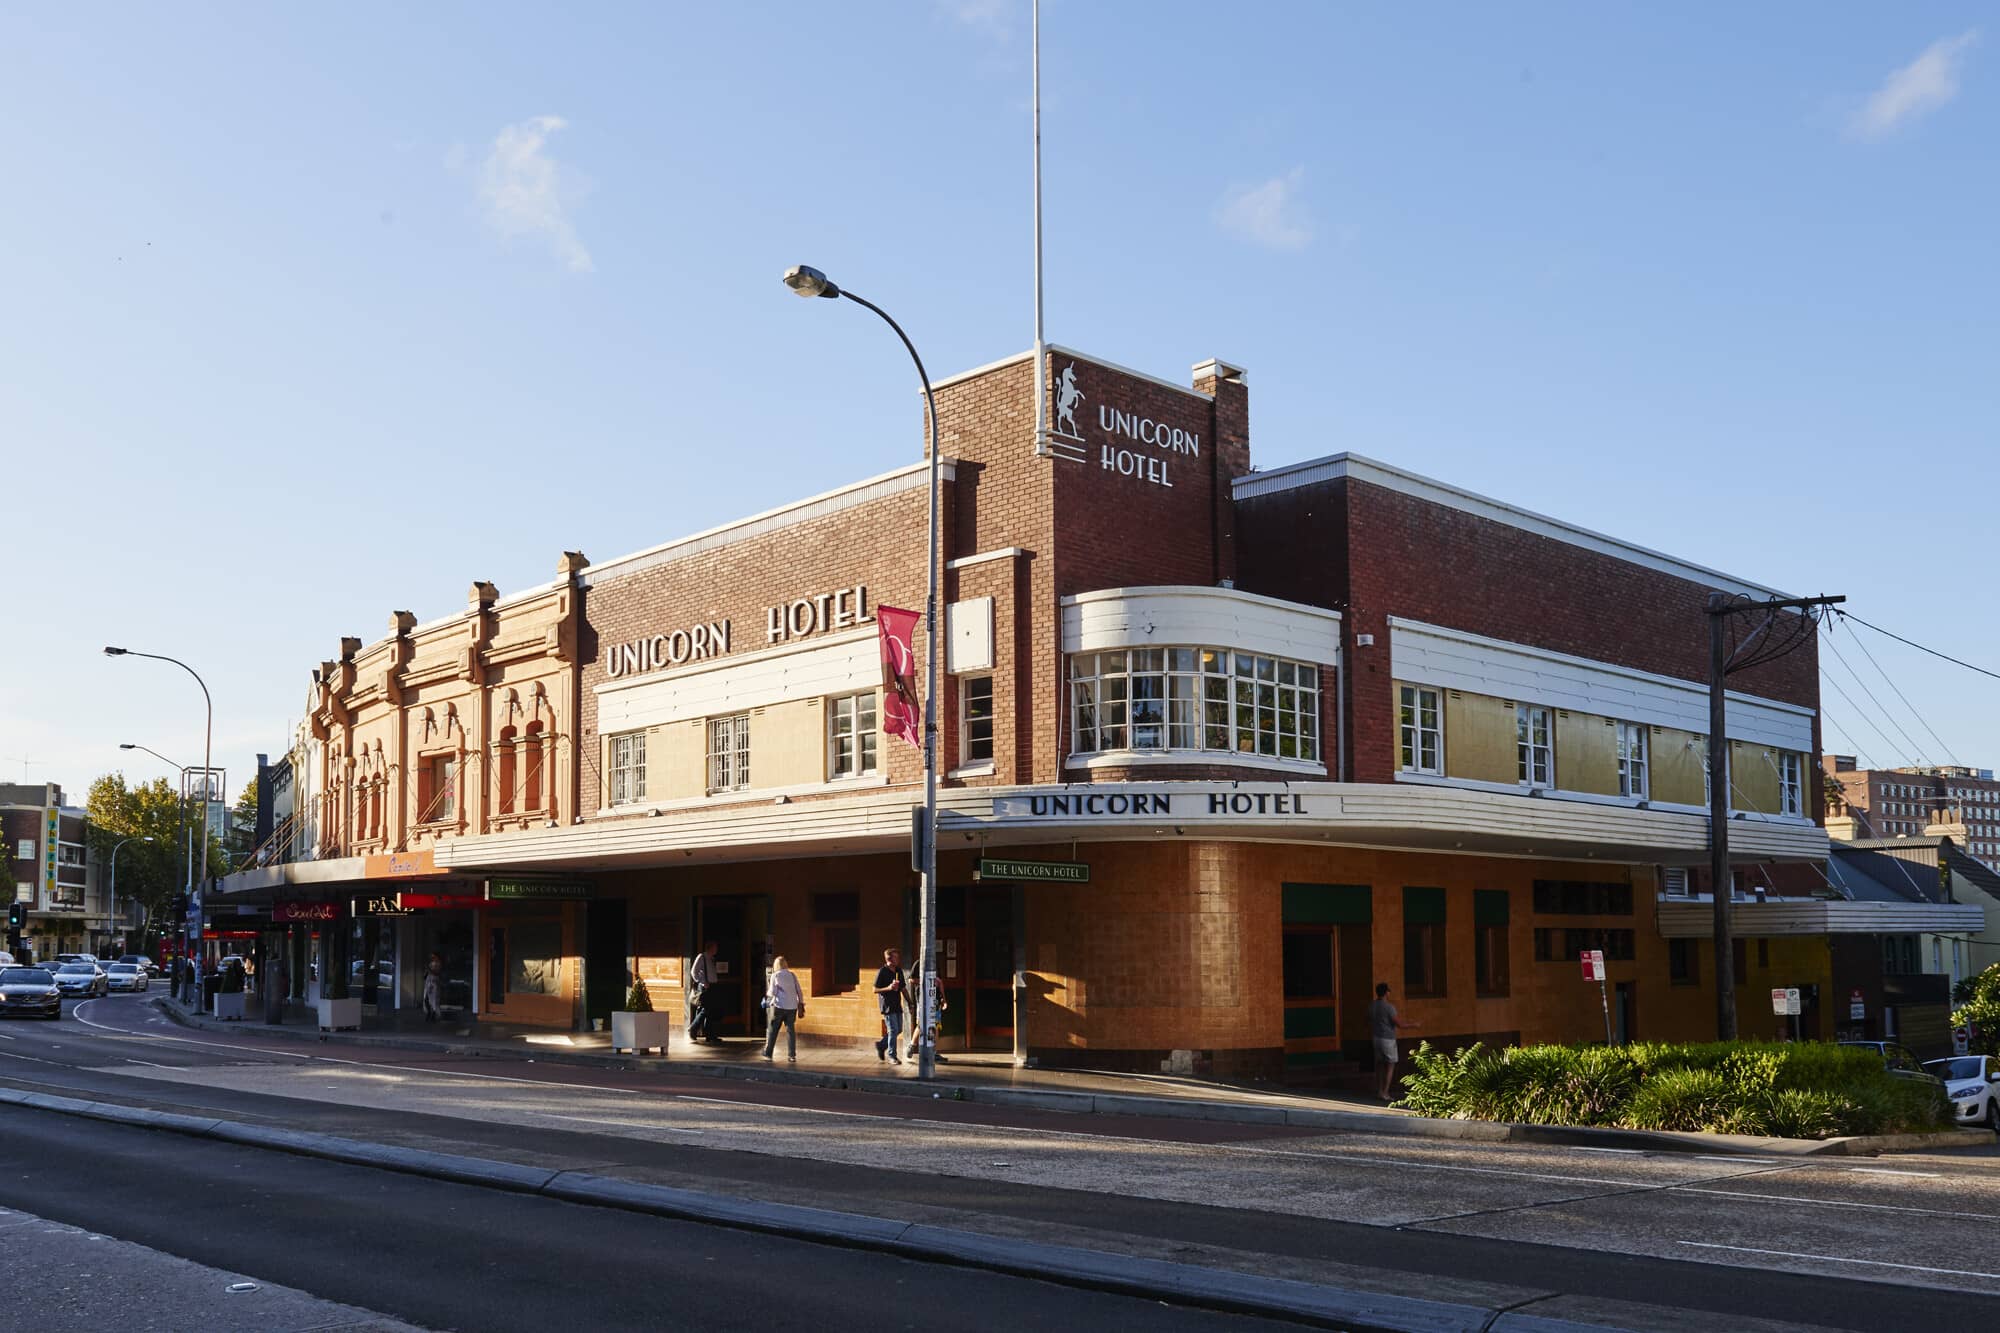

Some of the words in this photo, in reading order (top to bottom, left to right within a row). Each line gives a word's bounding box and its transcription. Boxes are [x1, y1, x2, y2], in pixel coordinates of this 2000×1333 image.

[1100, 405, 1199, 457] UNICORN
[1100, 445, 1173, 487] HOTEL
[607, 619, 731, 678] UNICORN
[767, 586, 876, 643] HOTEL
[1030, 794, 1171, 816] UNICORN
[1209, 793, 1308, 815] HOTEL
[991, 863, 1008, 877] THE
[1011, 864, 1051, 878] UNICORN
[1053, 866, 1080, 879] HOTEL
[500, 883, 516, 893] THE
